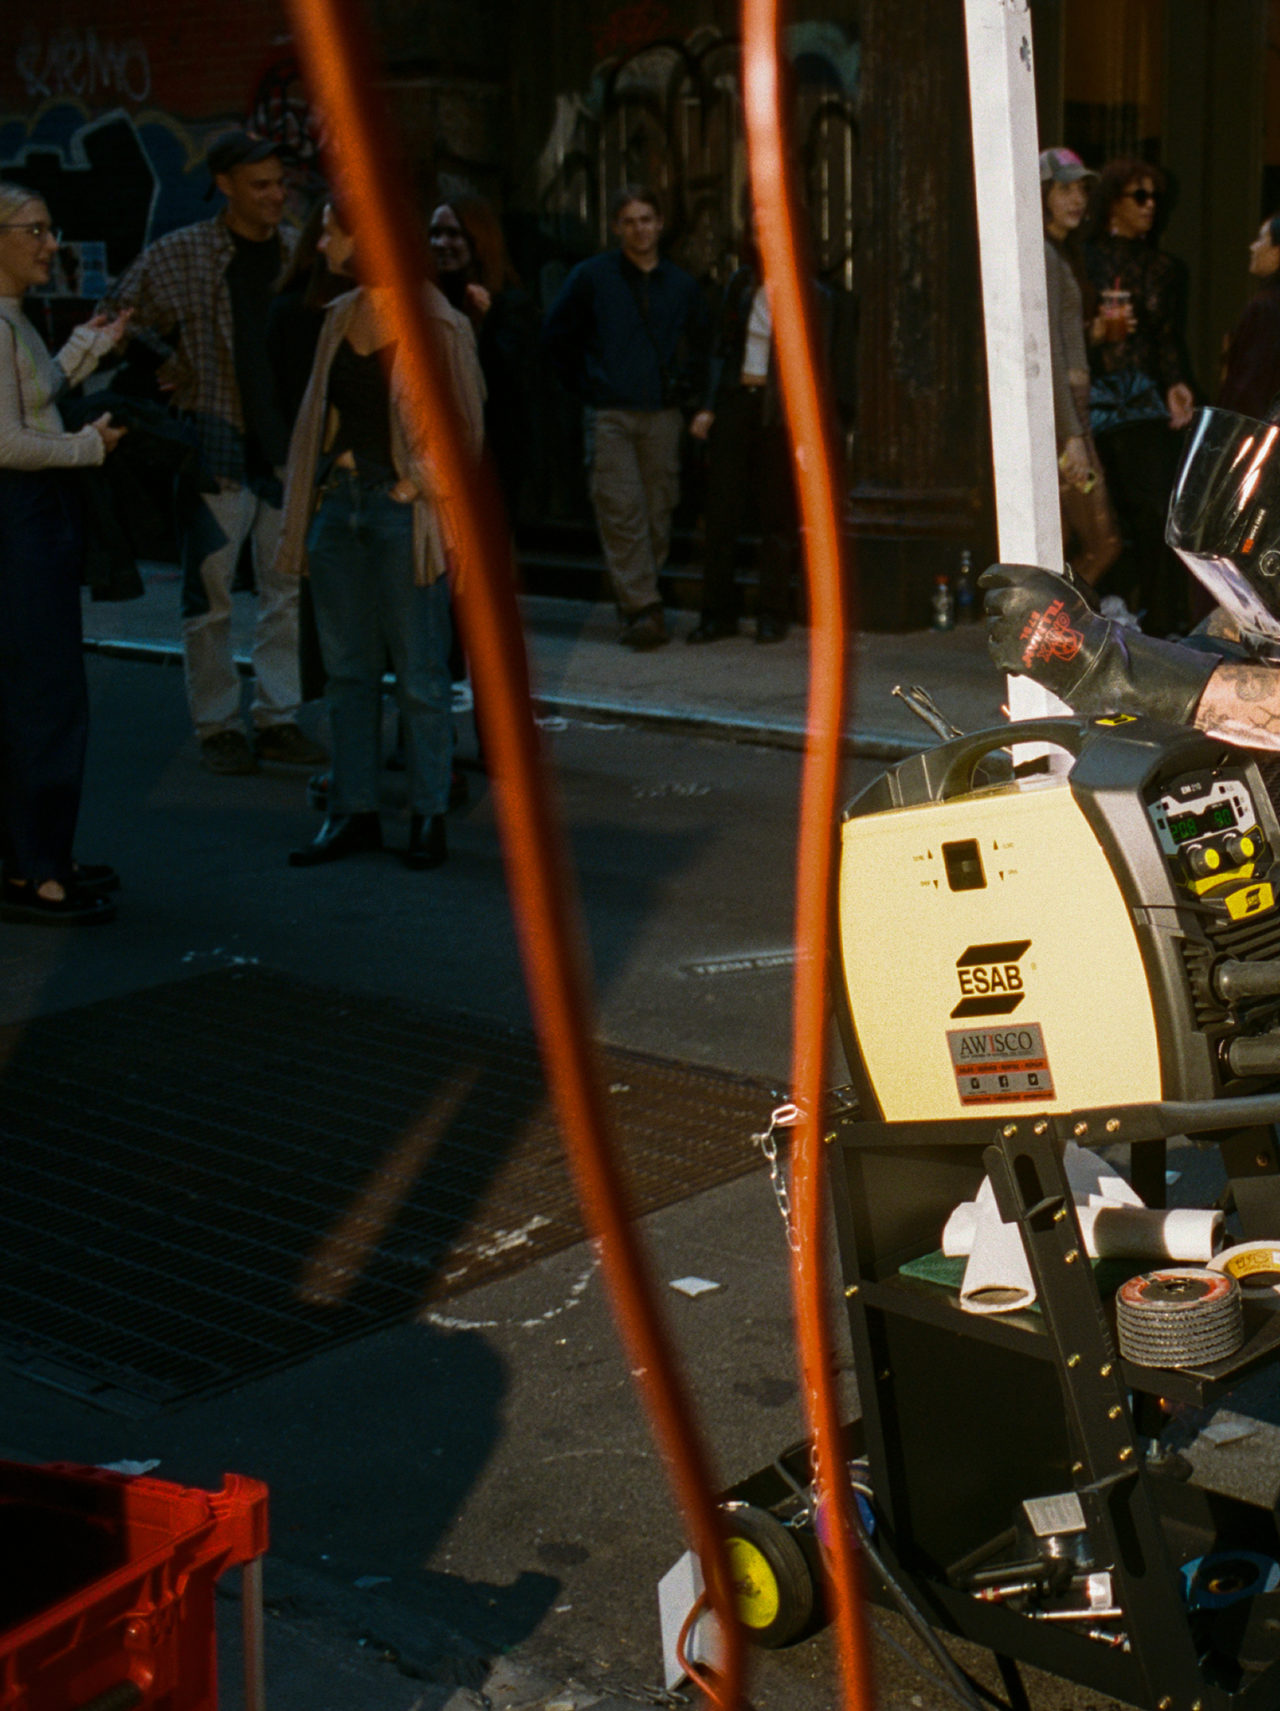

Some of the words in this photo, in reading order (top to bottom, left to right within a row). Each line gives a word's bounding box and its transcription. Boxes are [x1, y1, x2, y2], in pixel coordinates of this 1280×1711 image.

[1022, 599, 1065, 668] TILLMAN
[957, 964, 1024, 995] ESAB
[960, 1031, 1033, 1057] AWISCO
